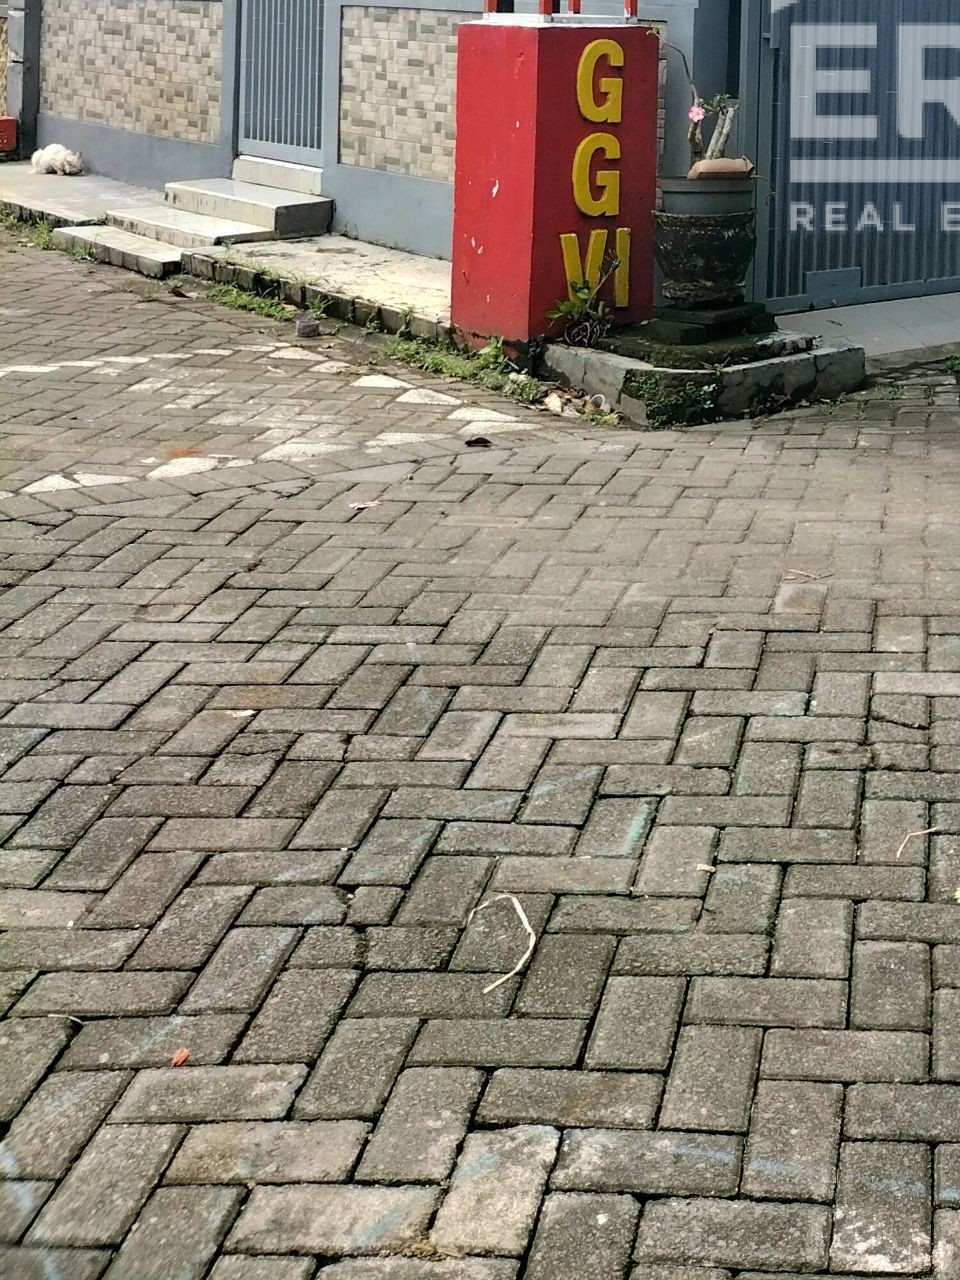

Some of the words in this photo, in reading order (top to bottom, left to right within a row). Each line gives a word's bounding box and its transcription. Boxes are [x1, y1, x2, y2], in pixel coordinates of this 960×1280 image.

[576, 38, 624, 123] G
[571, 132, 621, 216] G
[560, 227, 631, 308] VI
